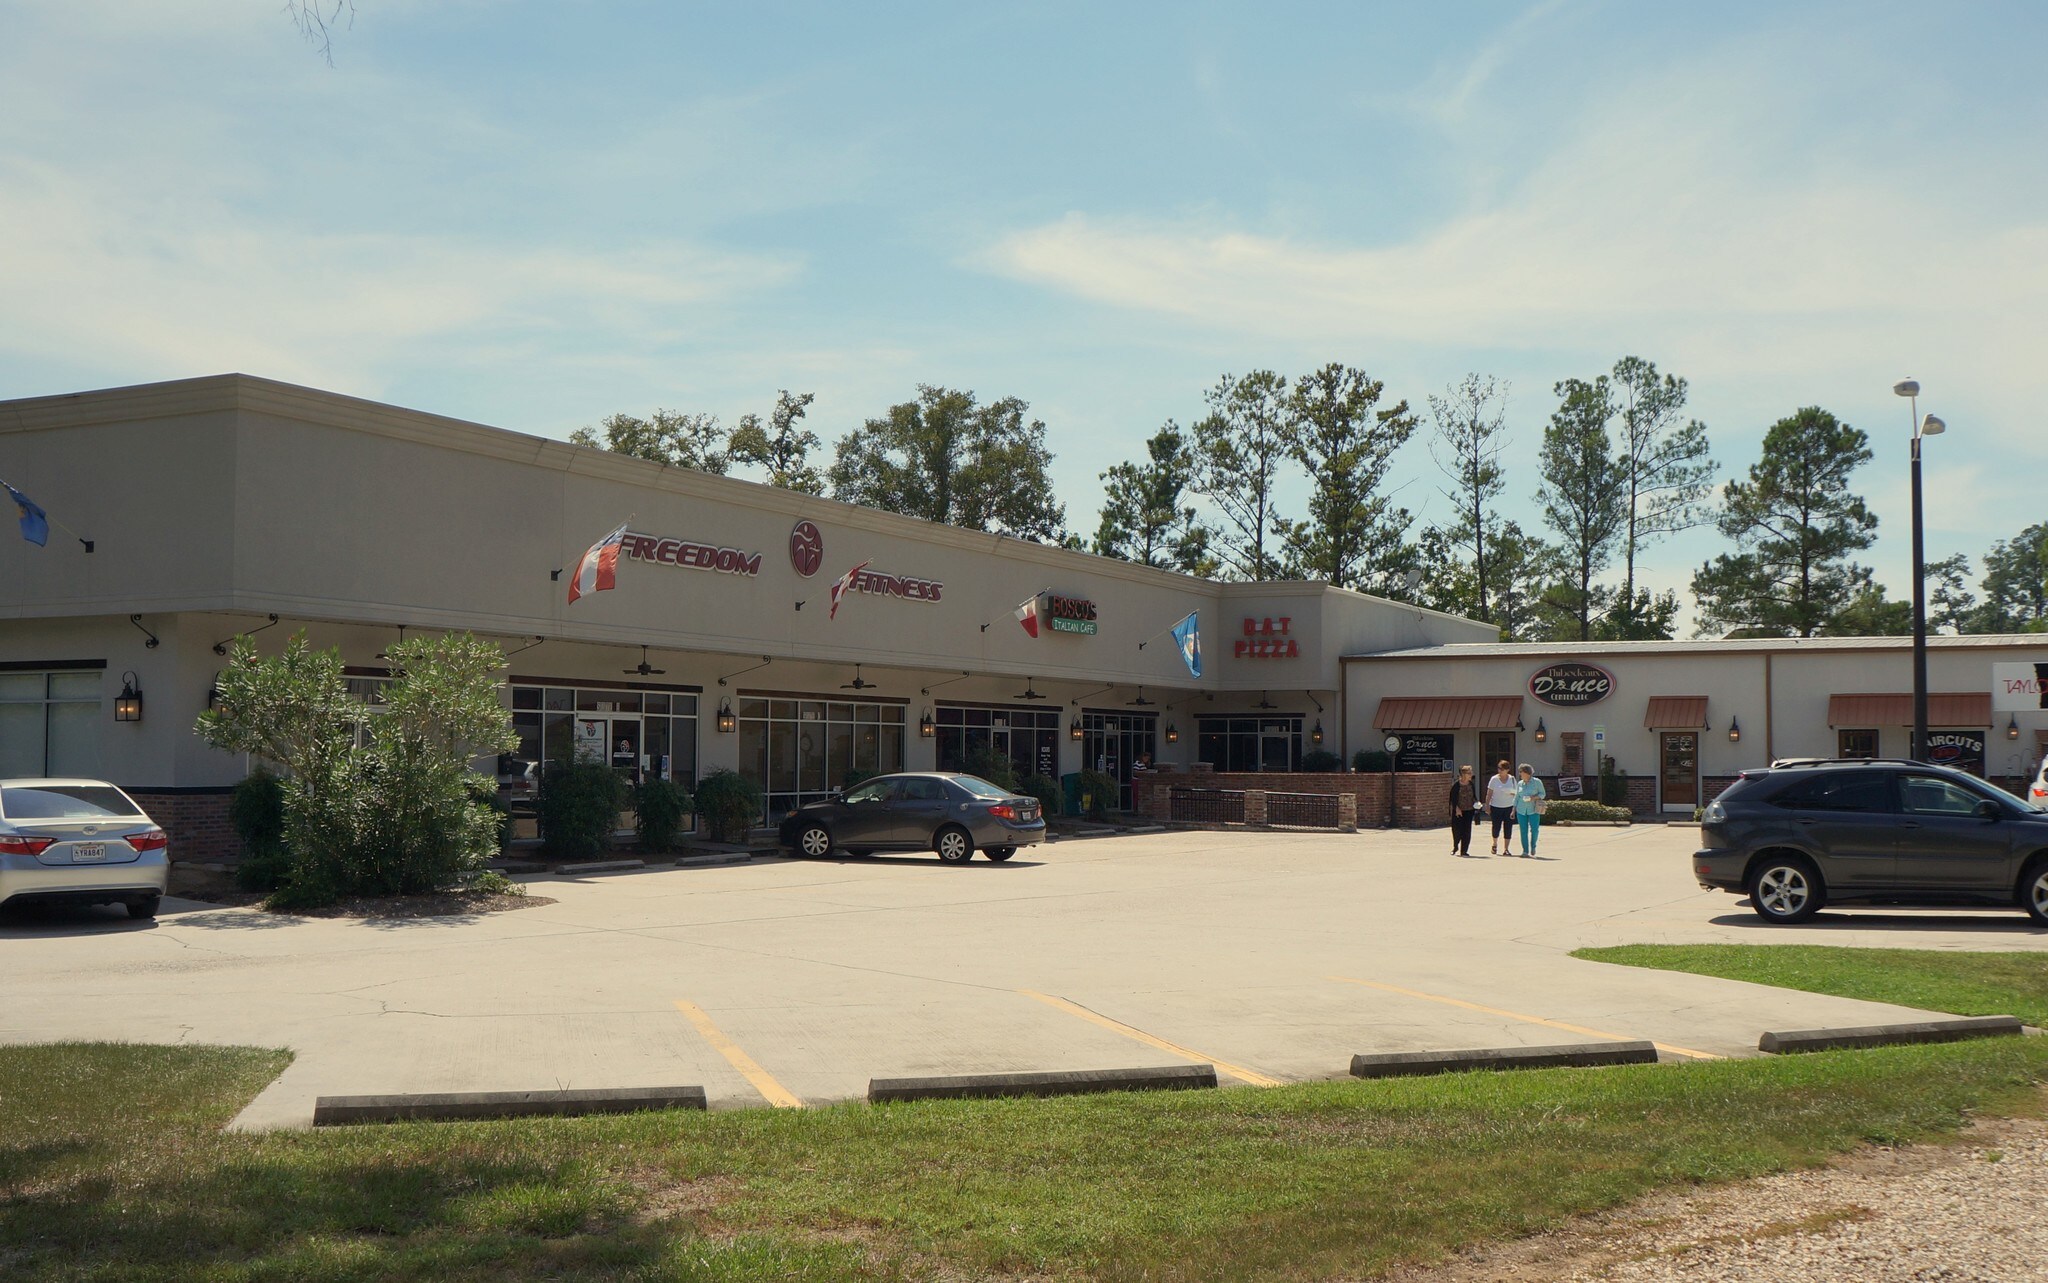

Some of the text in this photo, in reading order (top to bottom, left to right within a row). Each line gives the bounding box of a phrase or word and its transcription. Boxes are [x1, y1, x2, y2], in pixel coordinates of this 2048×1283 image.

[618, 531, 944, 603] FREEDOM FITNESS
[1054, 619, 1094, 634] ITALIAN CAFE
[1243, 617, 1291, 636] DAT
[1234, 640, 1299, 658] PIZZA
[1911, 735, 1983, 752] AIRCUTS
